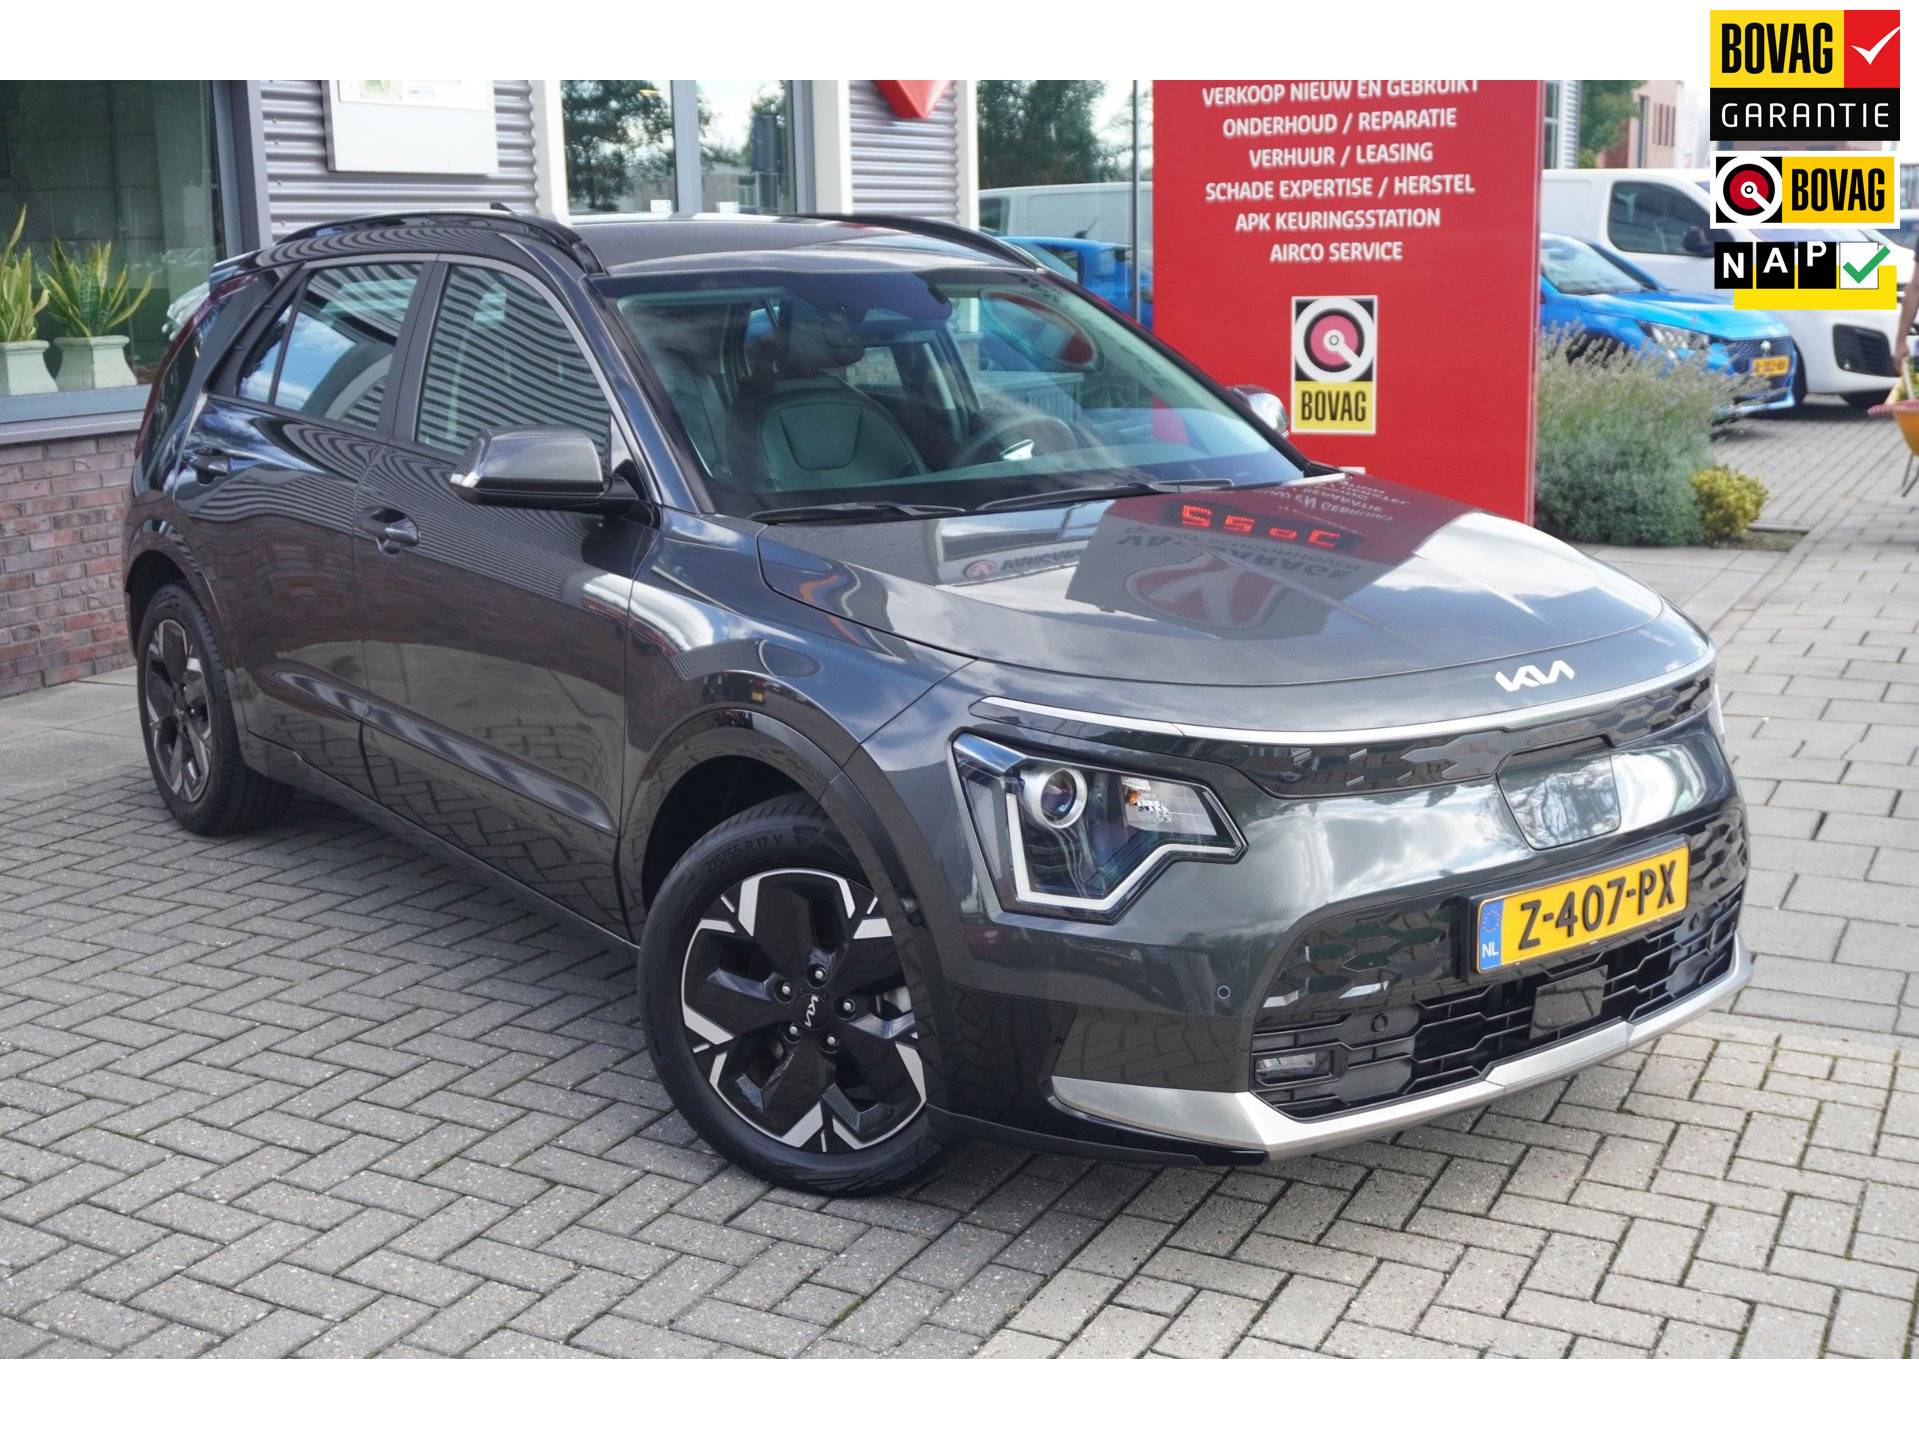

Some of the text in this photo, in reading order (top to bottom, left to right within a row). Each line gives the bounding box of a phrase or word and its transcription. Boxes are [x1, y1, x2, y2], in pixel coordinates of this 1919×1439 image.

[1202, 80, 1479, 107] VERKOOP NIEUW EN GEBRUIKT
[1223, 107, 1457, 138] ONDERHOUD / REPARATIE
[1249, 142, 1433, 169] VERHUUR / LEASING
[1205, 174, 1475, 202] SCHADE EXPERTISE / HERSTEL
[1235, 208, 1441, 232] APK KEURINGSSTATION
[1270, 241, 1403, 263] AIRCO SERVICE
[1301, 389, 1367, 423] BOVAG
[1495, 660, 1575, 692] KIA
[704, 834, 784, 873] 215/55 R 17 V
[1518, 860, 1677, 951] Z-407-PX
[1482, 940, 1499, 959] NL
